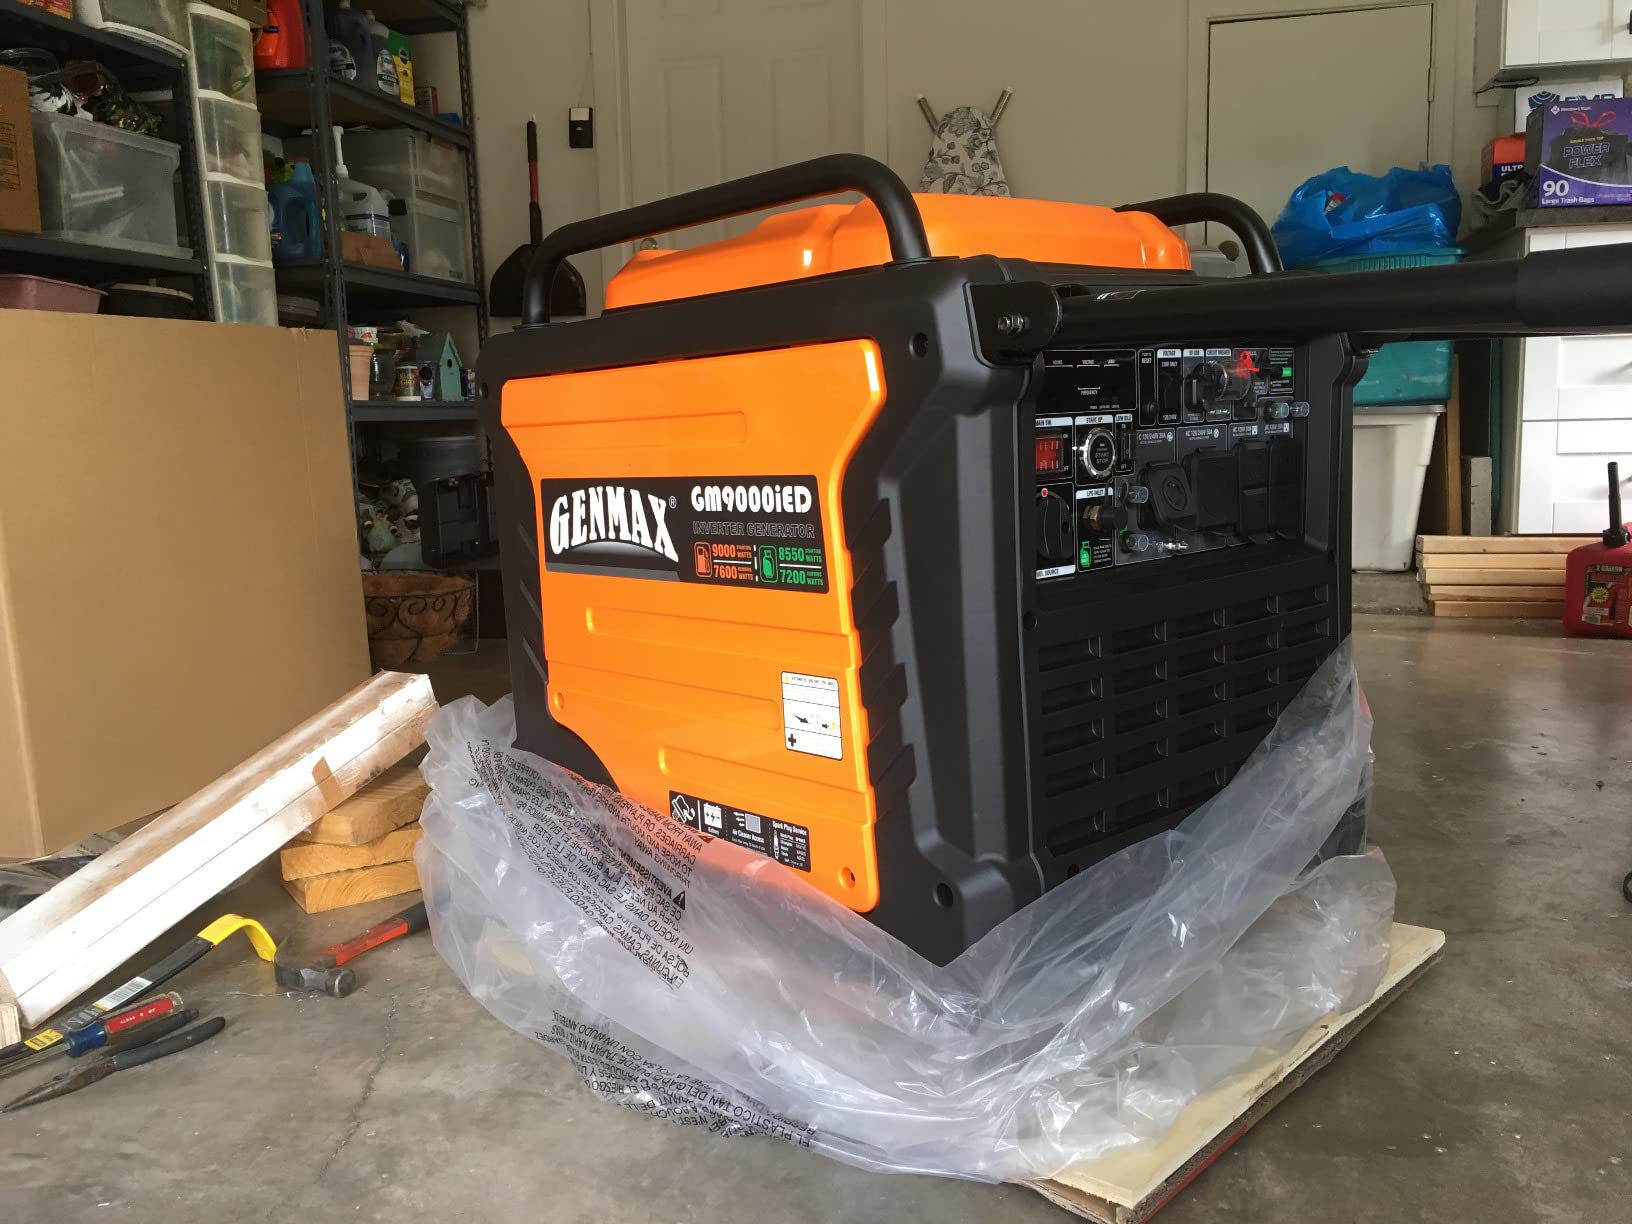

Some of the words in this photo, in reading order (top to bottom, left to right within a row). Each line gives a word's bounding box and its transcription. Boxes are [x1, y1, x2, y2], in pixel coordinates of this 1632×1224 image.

[1563, 142, 1610, 157] POWER
[1569, 156, 1602, 169] FLEX
[1543, 180, 1570, 196] 90
[691, 484, 812, 513] GM9000iED
[550, 486, 679, 563] GENMAX
[692, 521, 744, 536] INVERTER
[746, 523, 816, 538] GENERATOR
[712, 544, 736, 558] 9000
[736, 551, 752, 559] WATTS
[779, 547, 804, 562] 8550
[806, 555, 822, 563] WATTS
[714, 564, 738, 580] 7600
[738, 572, 754, 580] WATTS
[780, 570, 806, 584] 7200
[807, 577, 824, 586] WATTS
[772, 820, 783, 829] Spark
[783, 823, 793, 832] Plug
[793, 825, 807, 836] Service
[578, 1024, 605, 1042] NUDO
[605, 1037, 619, 1048] UN
[589, 1043, 618, 1062] TAPAR
[619, 1045, 641, 1061] CON
[618, 1056, 652, 1077] PUEDE
[653, 1074, 708, 1101] DELGADO
[709, 1095, 731, 1112] TAN
[733, 1105, 792, 1140] PLASTICO
